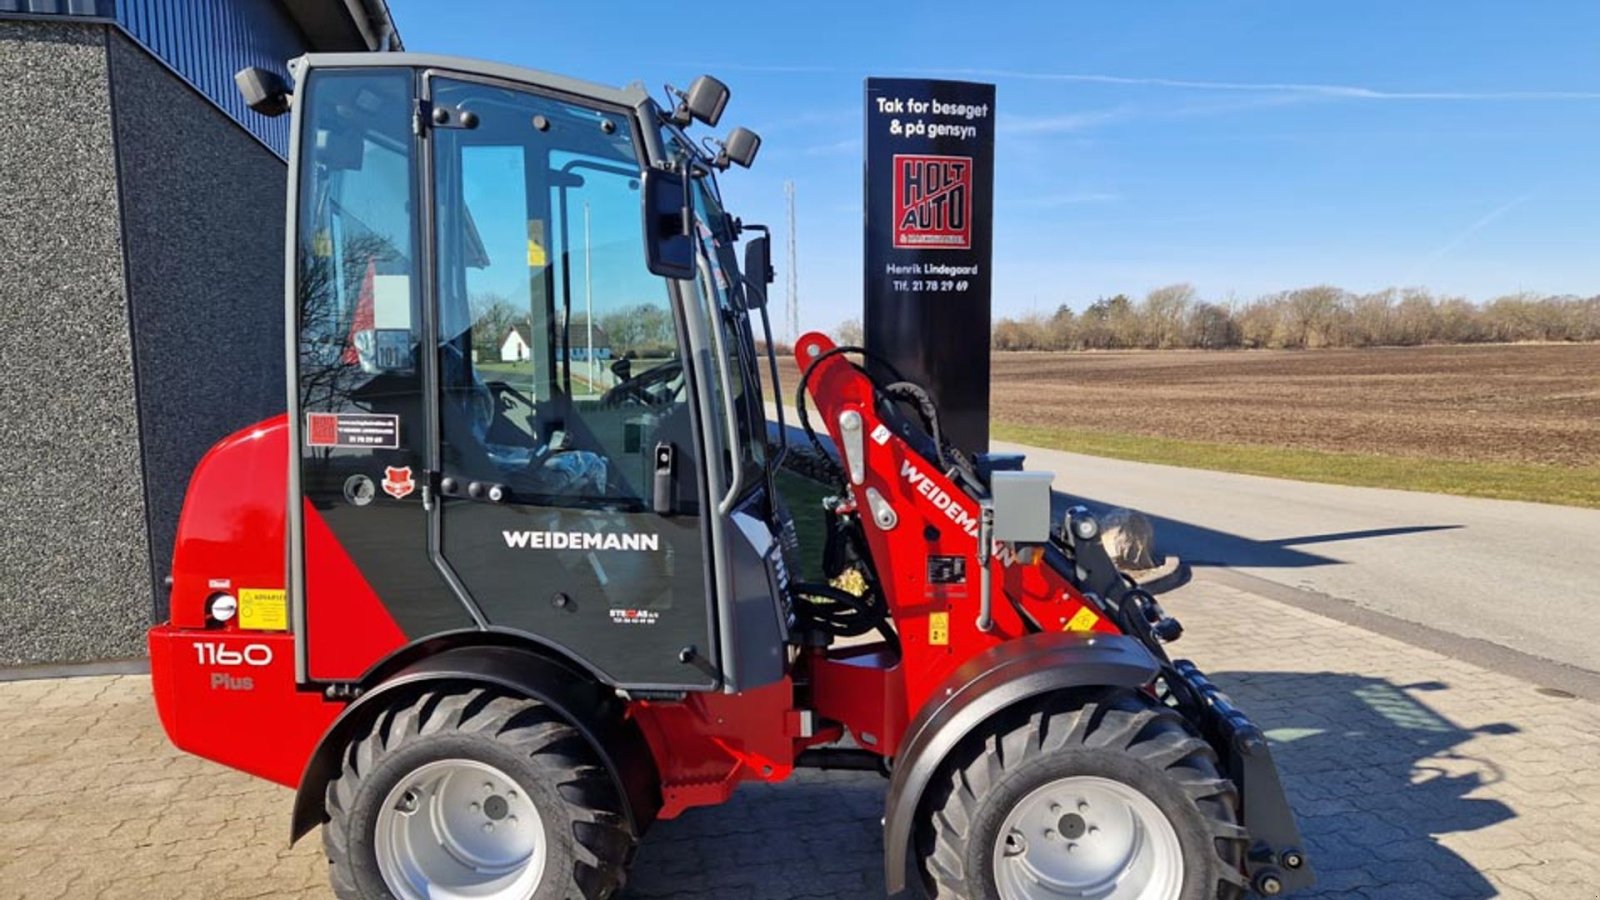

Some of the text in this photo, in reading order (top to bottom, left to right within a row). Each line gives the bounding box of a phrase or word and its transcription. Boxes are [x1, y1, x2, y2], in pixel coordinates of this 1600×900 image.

[876, 97, 988, 120] Tak for besøget
[889, 118, 977, 140] & på gensyn
[903, 160, 966, 208] HOLT
[899, 182, 966, 231] AUTO
[886, 263, 979, 277] Henrik Lindegaard
[893, 280, 969, 292] Tlf. 21 78 29 69
[901, 458, 1016, 568] WEIDEMN
[502, 530, 659, 551] WEIDEMANN
[193, 641, 273, 666] 1160
[210, 672, 254, 690] Plus
